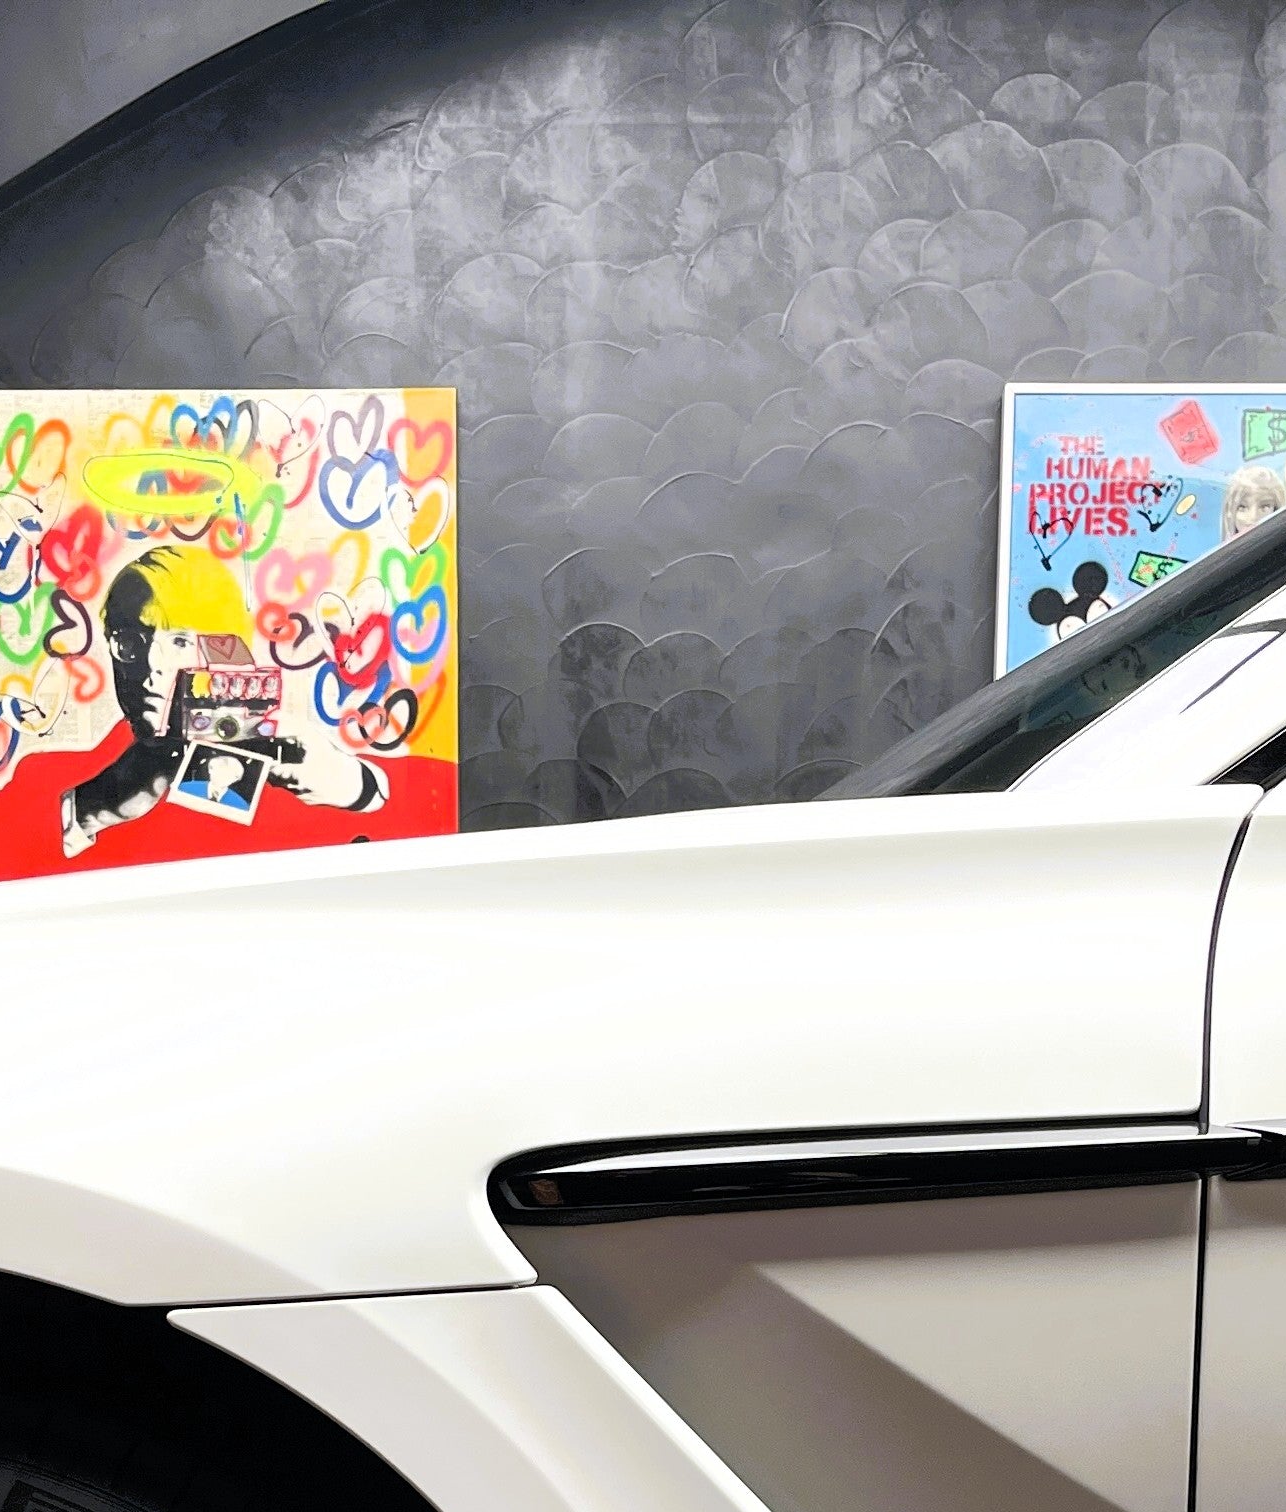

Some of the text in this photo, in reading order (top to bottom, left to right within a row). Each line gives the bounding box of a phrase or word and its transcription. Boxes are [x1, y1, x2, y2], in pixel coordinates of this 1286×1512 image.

[1058, 435, 1105, 455] THE
[1046, 456, 1151, 480] HUMAN
[1029, 481, 1162, 505] PROJECT
[1028, 506, 1137, 536] LIVES.
